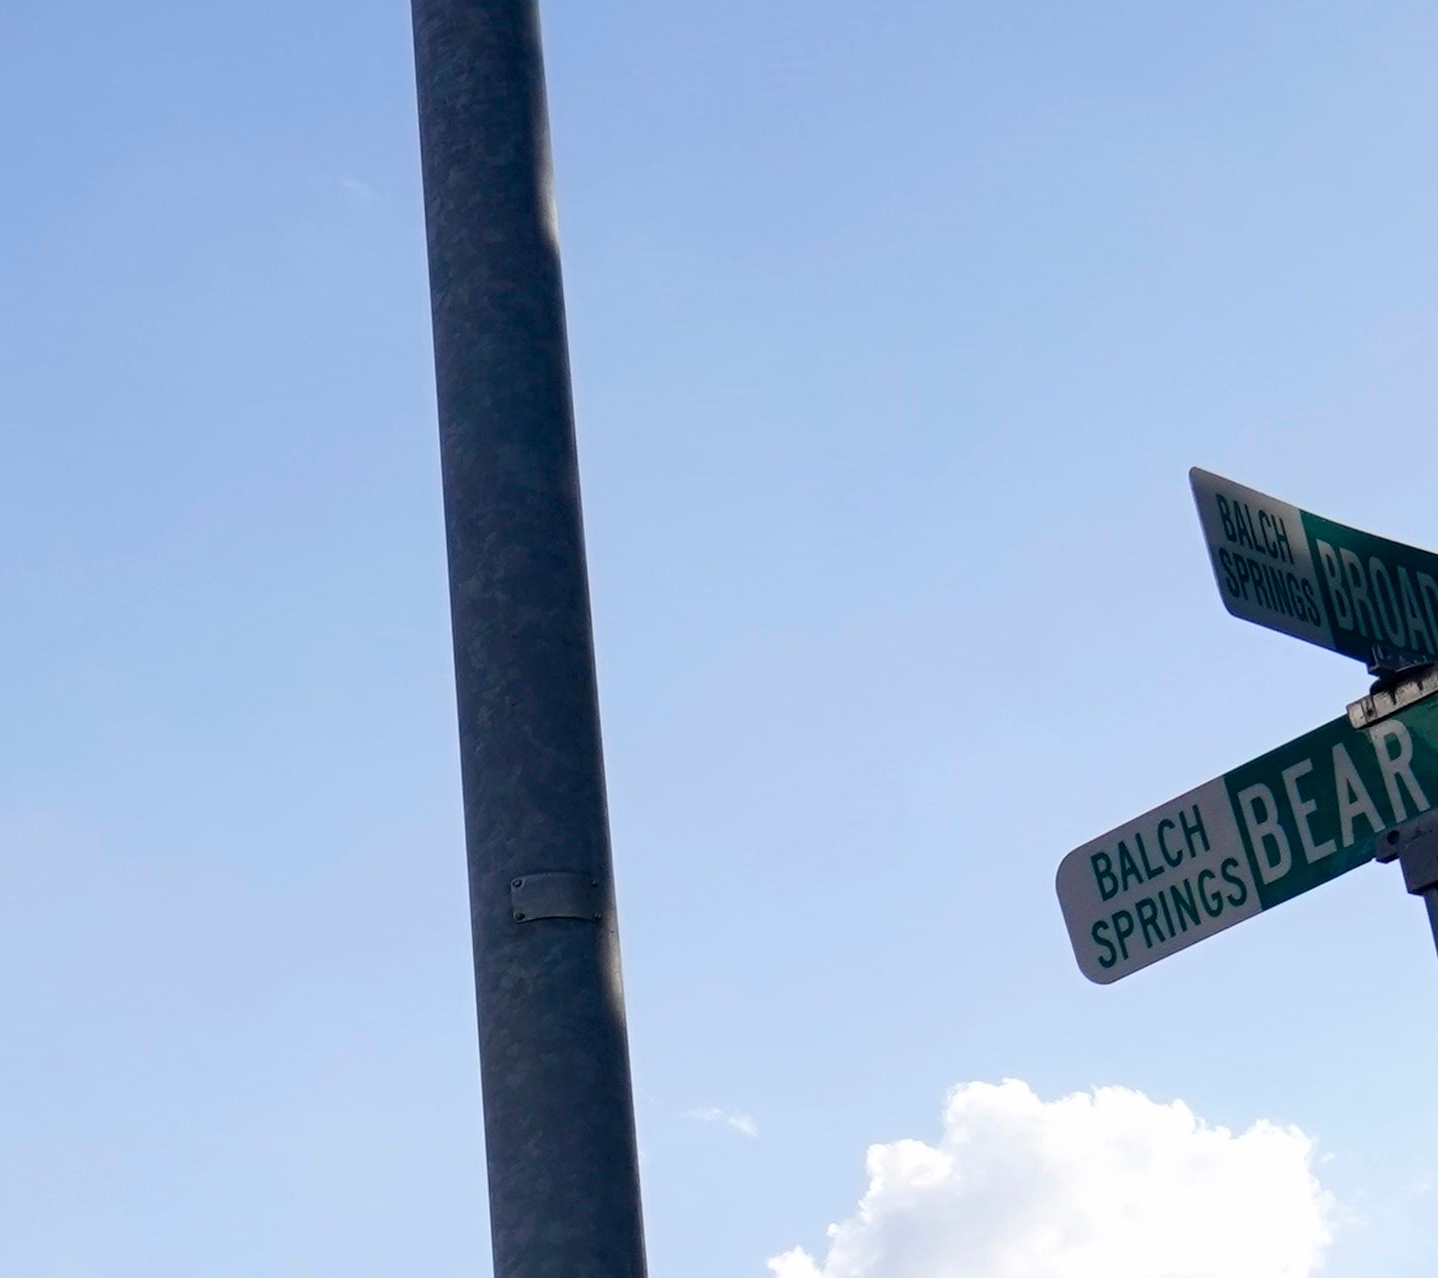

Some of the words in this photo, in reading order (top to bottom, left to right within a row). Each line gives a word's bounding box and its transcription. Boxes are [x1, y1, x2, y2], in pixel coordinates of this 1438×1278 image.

[1216, 492, 1290, 562] BALCH
[1219, 547, 1322, 629] SPRINGS
[1237, 718, 1431, 886] BEAR
[1091, 805, 1211, 903] BALCH
[1091, 857, 1248, 970] SPRINGS
